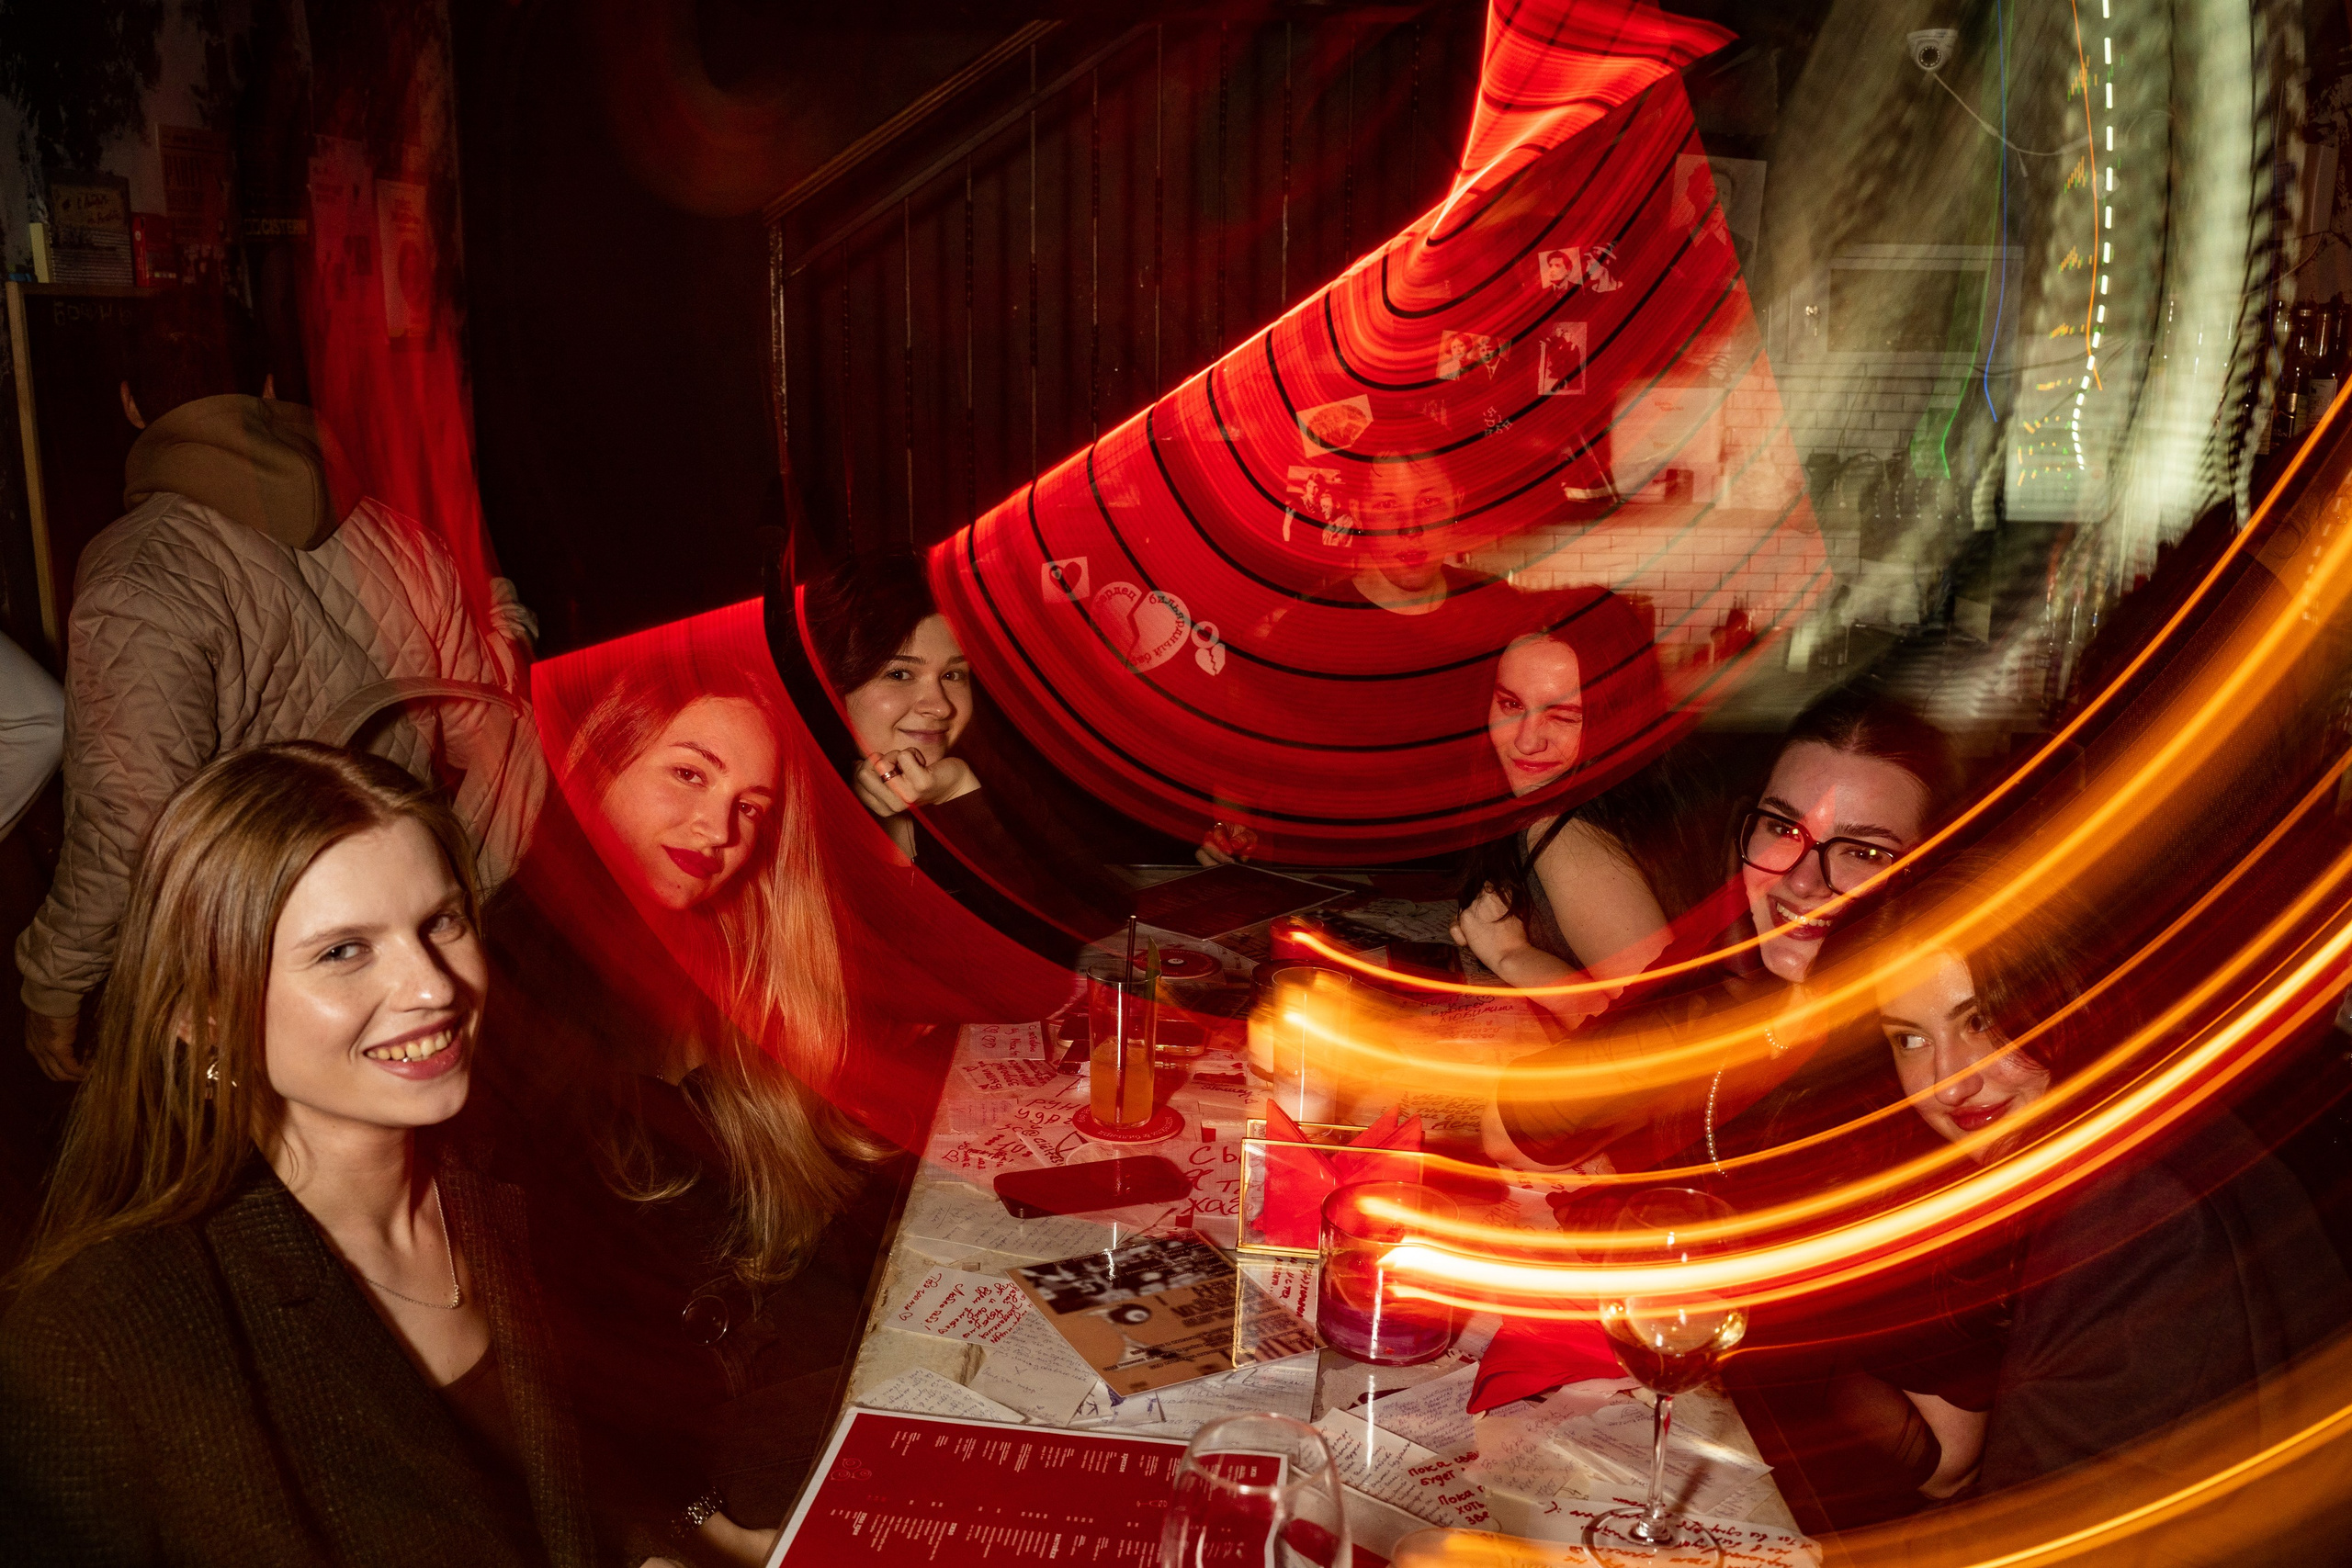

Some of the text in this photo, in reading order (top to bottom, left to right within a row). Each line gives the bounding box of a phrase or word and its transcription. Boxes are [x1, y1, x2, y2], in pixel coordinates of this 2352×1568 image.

[1148, 593, 1186, 658] бильярдный
[1408, 1461, 1452, 1477] Пока
[1438, 1490, 1475, 1506] Пока
[1455, 1501, 1485, 1515] хоть
